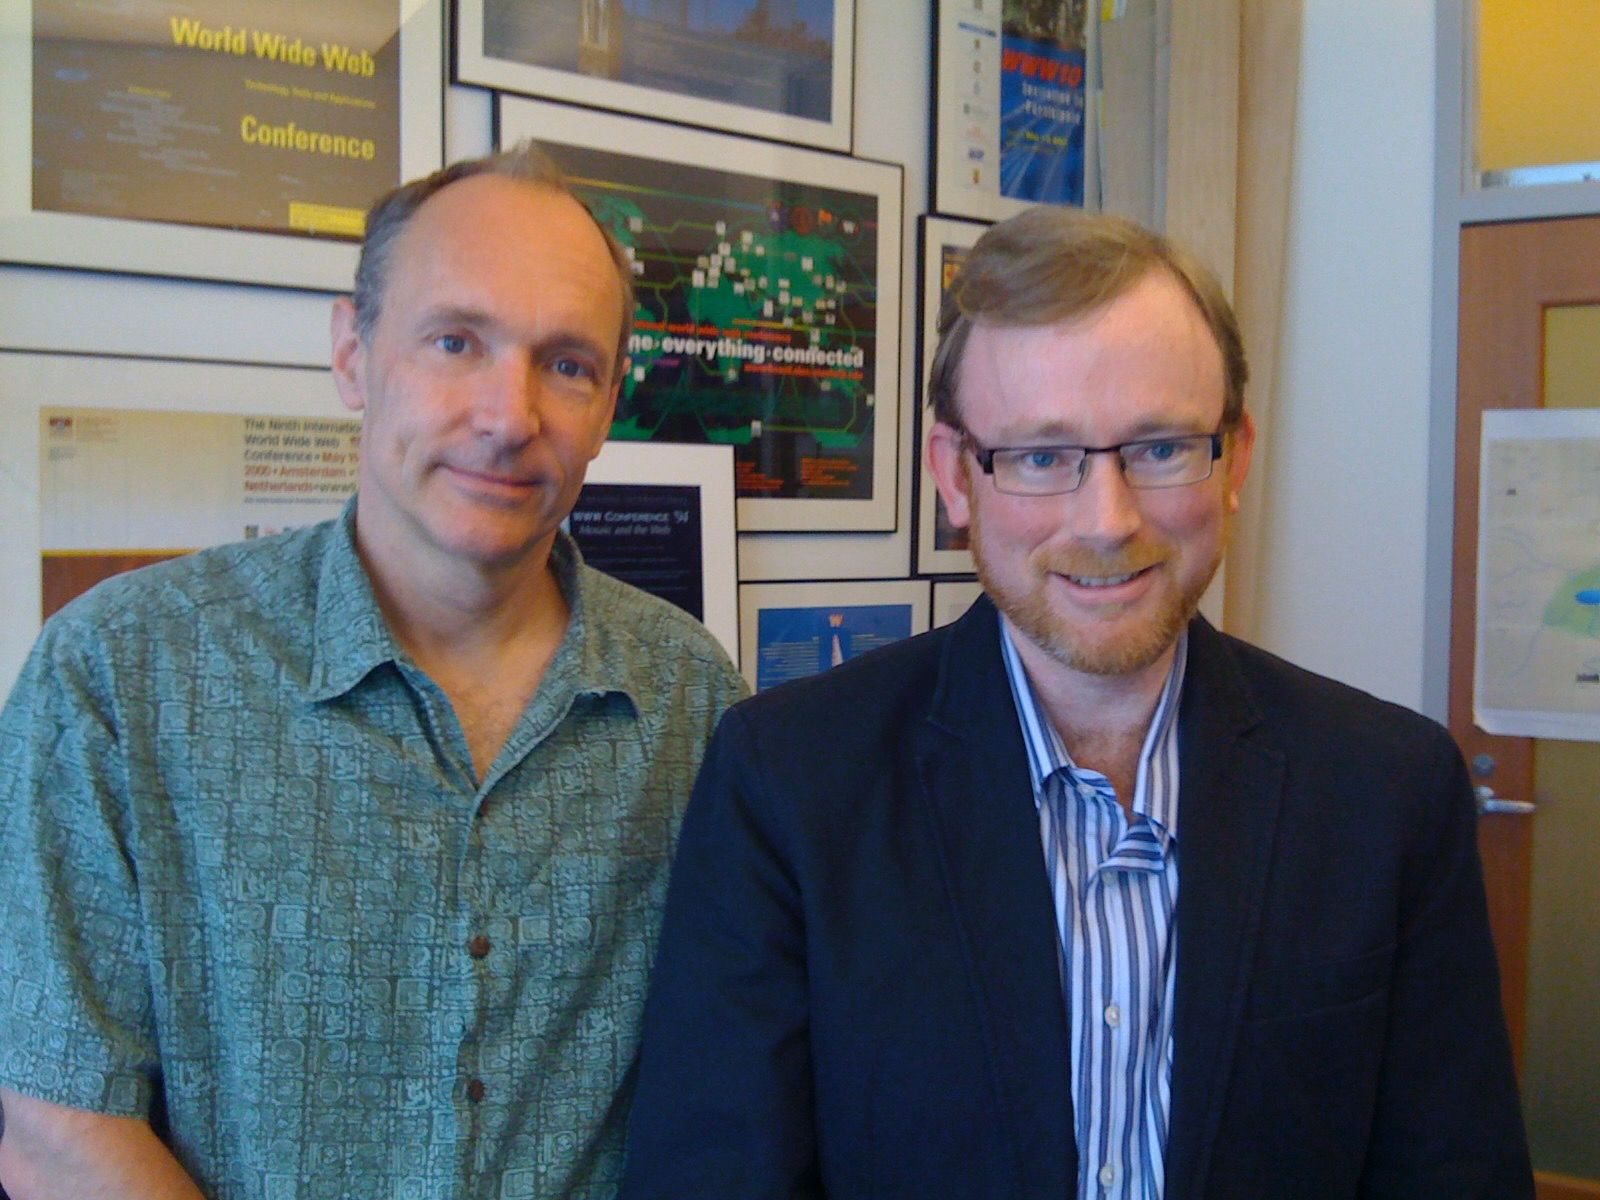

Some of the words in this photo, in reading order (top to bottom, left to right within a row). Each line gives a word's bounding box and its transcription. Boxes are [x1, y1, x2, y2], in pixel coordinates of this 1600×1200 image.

[170, 16, 246, 56] World
[253, 30, 315, 68] Wide
[322, 42, 375, 78] Web
[240, 114, 376, 161] Conference
[661, 336, 766, 364] everything
[772, 346, 864, 369] connected
[244, 418, 265, 431] The
[269, 419, 301, 432] Ninth
[244, 434, 280, 446] World
[282, 435, 311, 447] Wide
[315, 436, 340, 448] Web
[244, 448, 313, 461] Conference
[279, 465, 347, 477] Amsterdam
[573, 511, 602, 521] WWW
